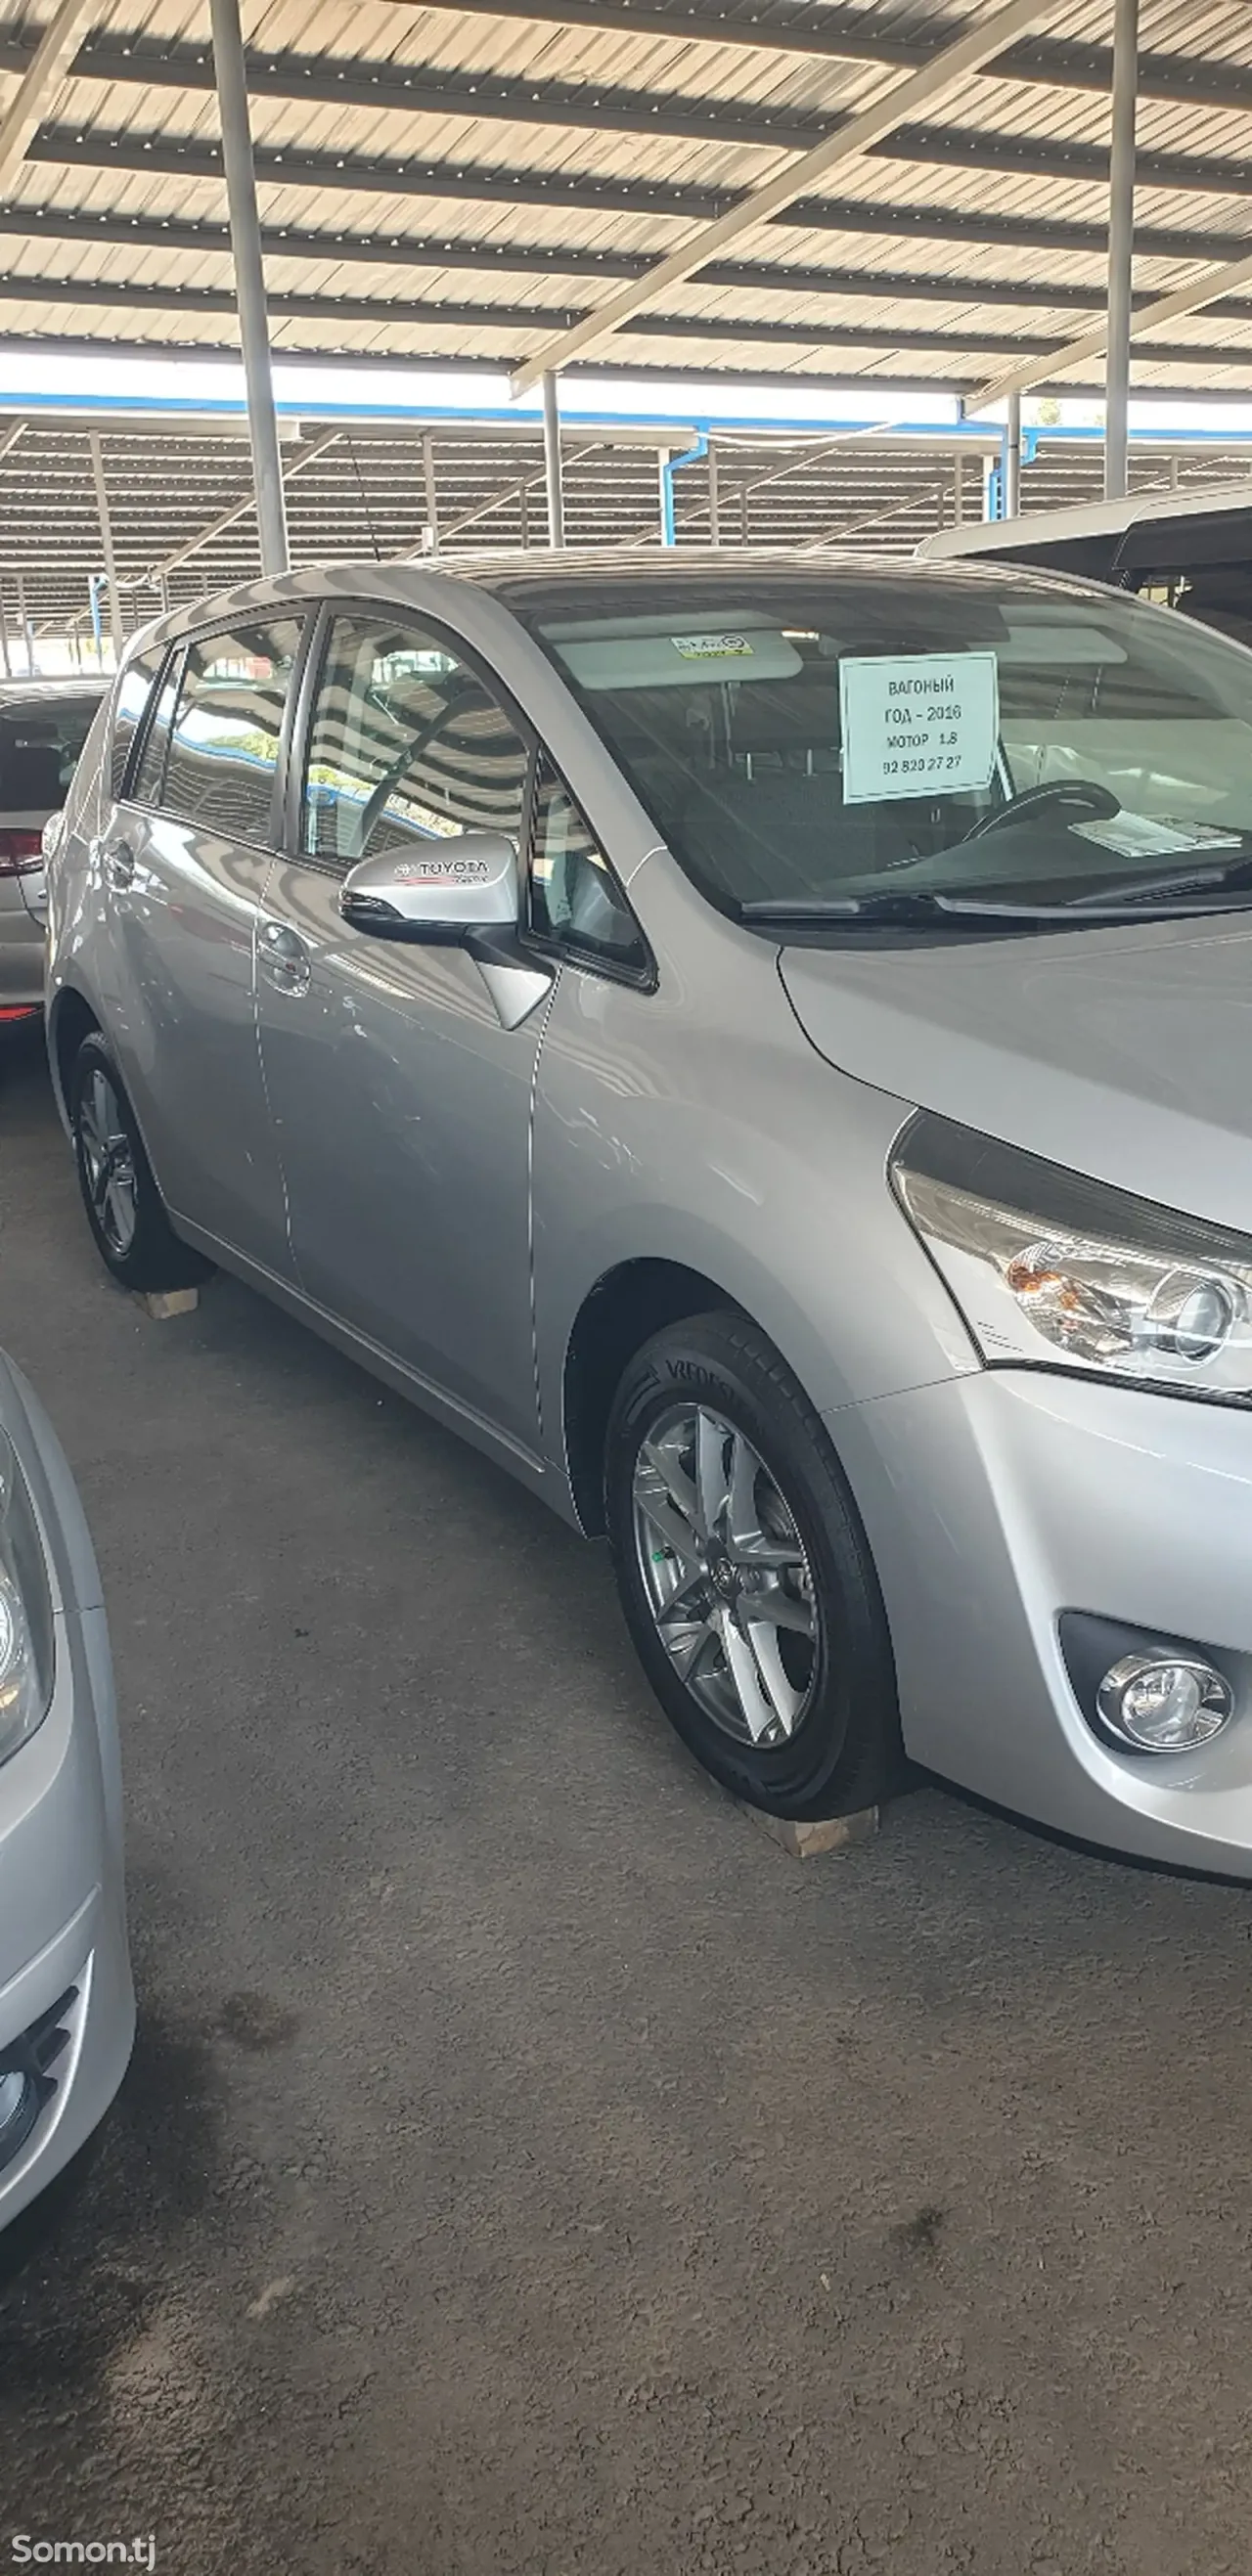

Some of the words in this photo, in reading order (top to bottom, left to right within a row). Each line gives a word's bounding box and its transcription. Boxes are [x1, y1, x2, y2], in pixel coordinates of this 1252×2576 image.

[888, 675, 955, 696] ВАГОНЫЙ
[884, 708, 912, 725] ГОД
[927, 704, 961, 722] 2016
[887, 733, 929, 749] МОТОР
[901, 758, 924, 774] 820
[927, 756, 944, 771] 27
[946, 754, 961, 770] 27
[420, 861, 488, 875] TOYOTA
